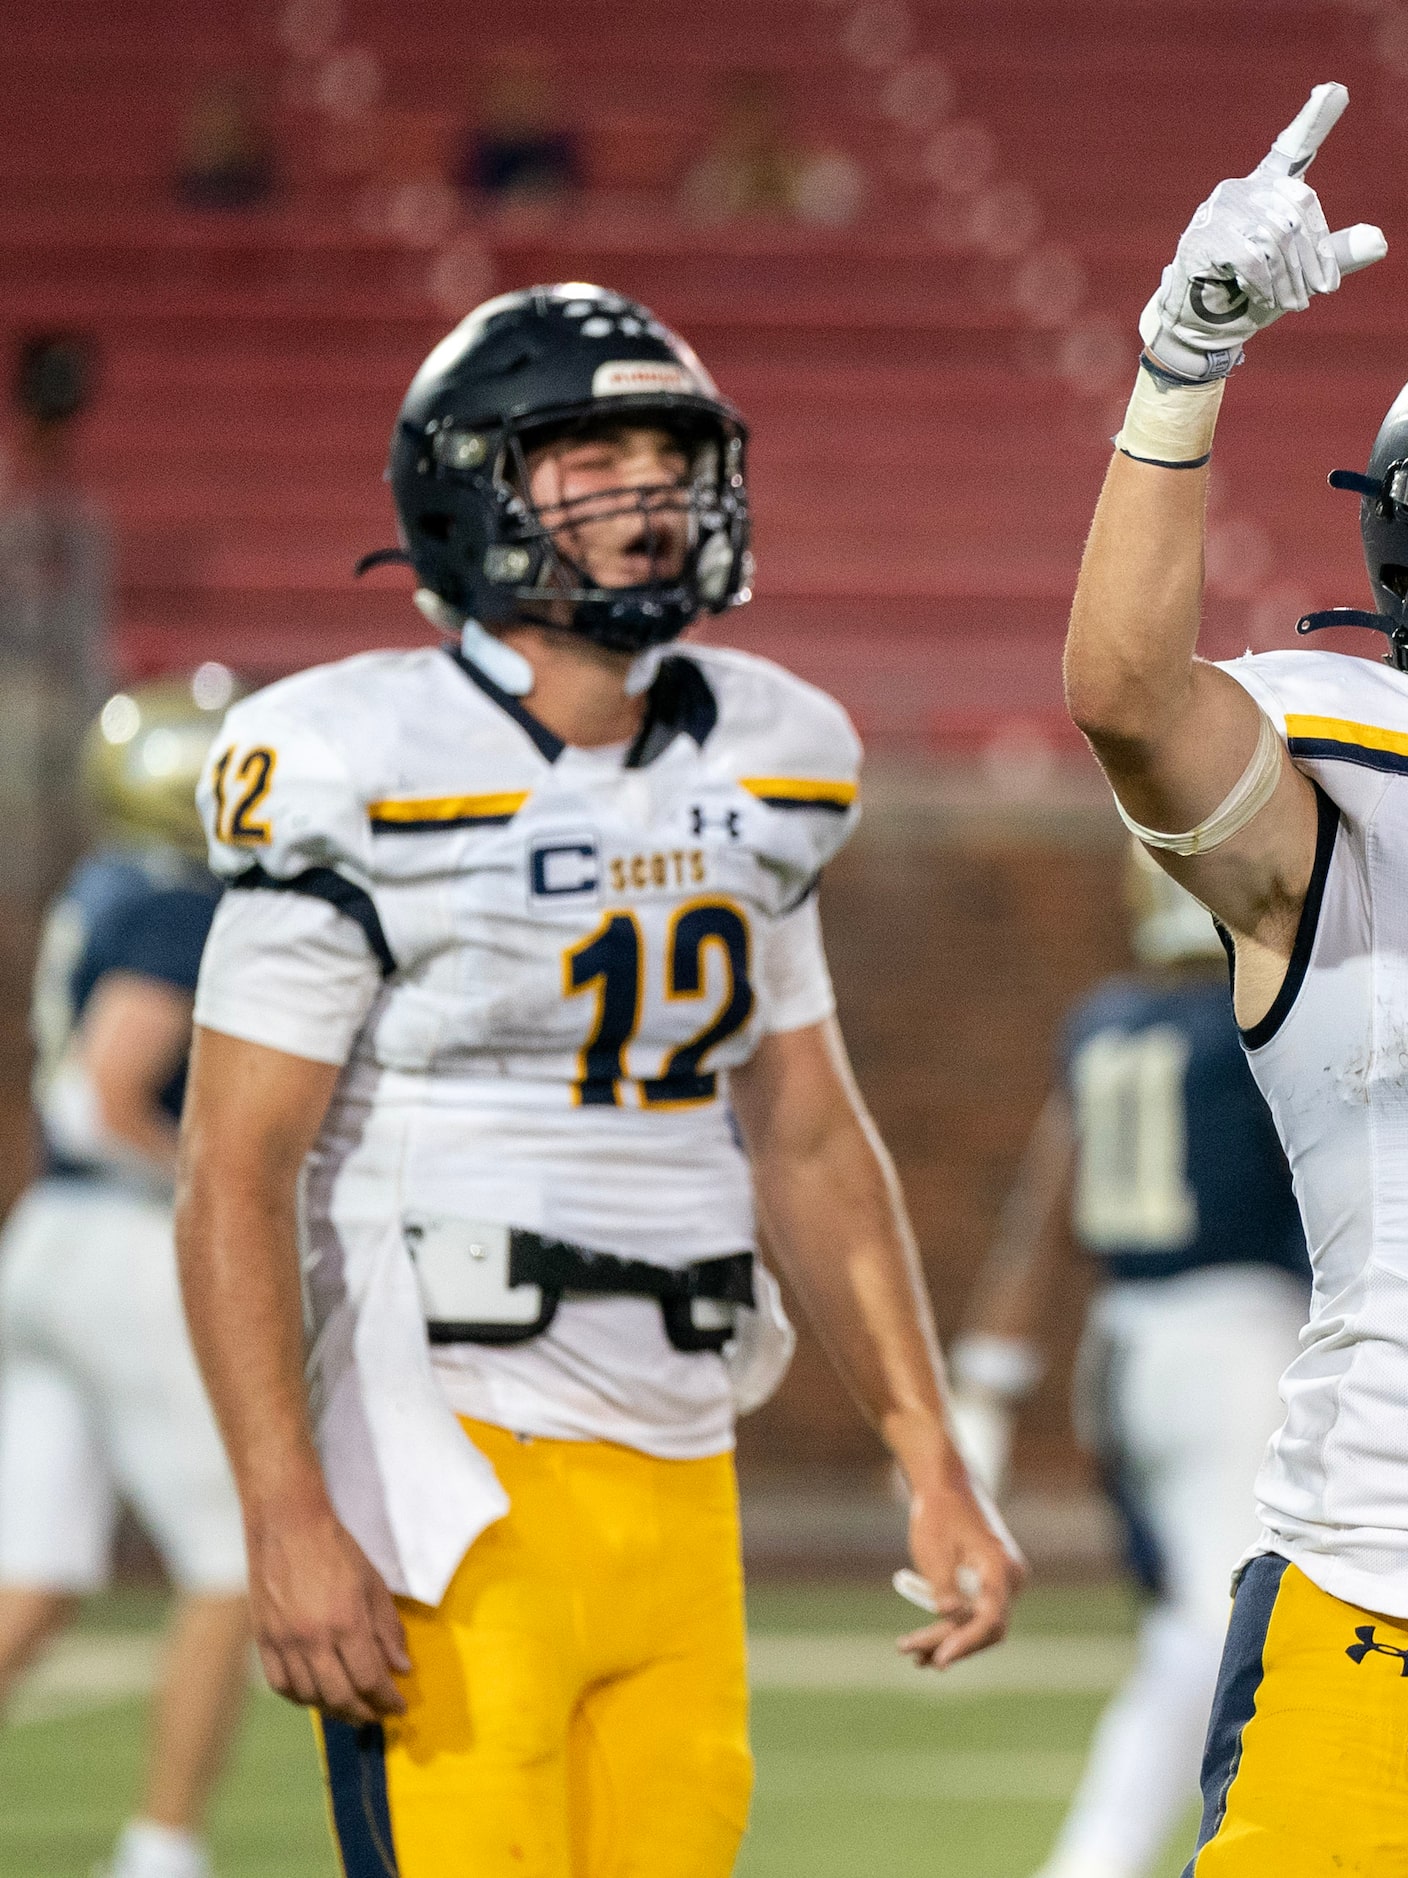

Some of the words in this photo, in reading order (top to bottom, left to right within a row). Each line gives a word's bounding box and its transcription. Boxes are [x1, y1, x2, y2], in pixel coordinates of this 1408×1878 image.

[212, 743, 276, 846] 12
[531, 844, 597, 895] C
[610, 849, 705, 893] SCOTS
[561, 894, 756, 1112] 12
